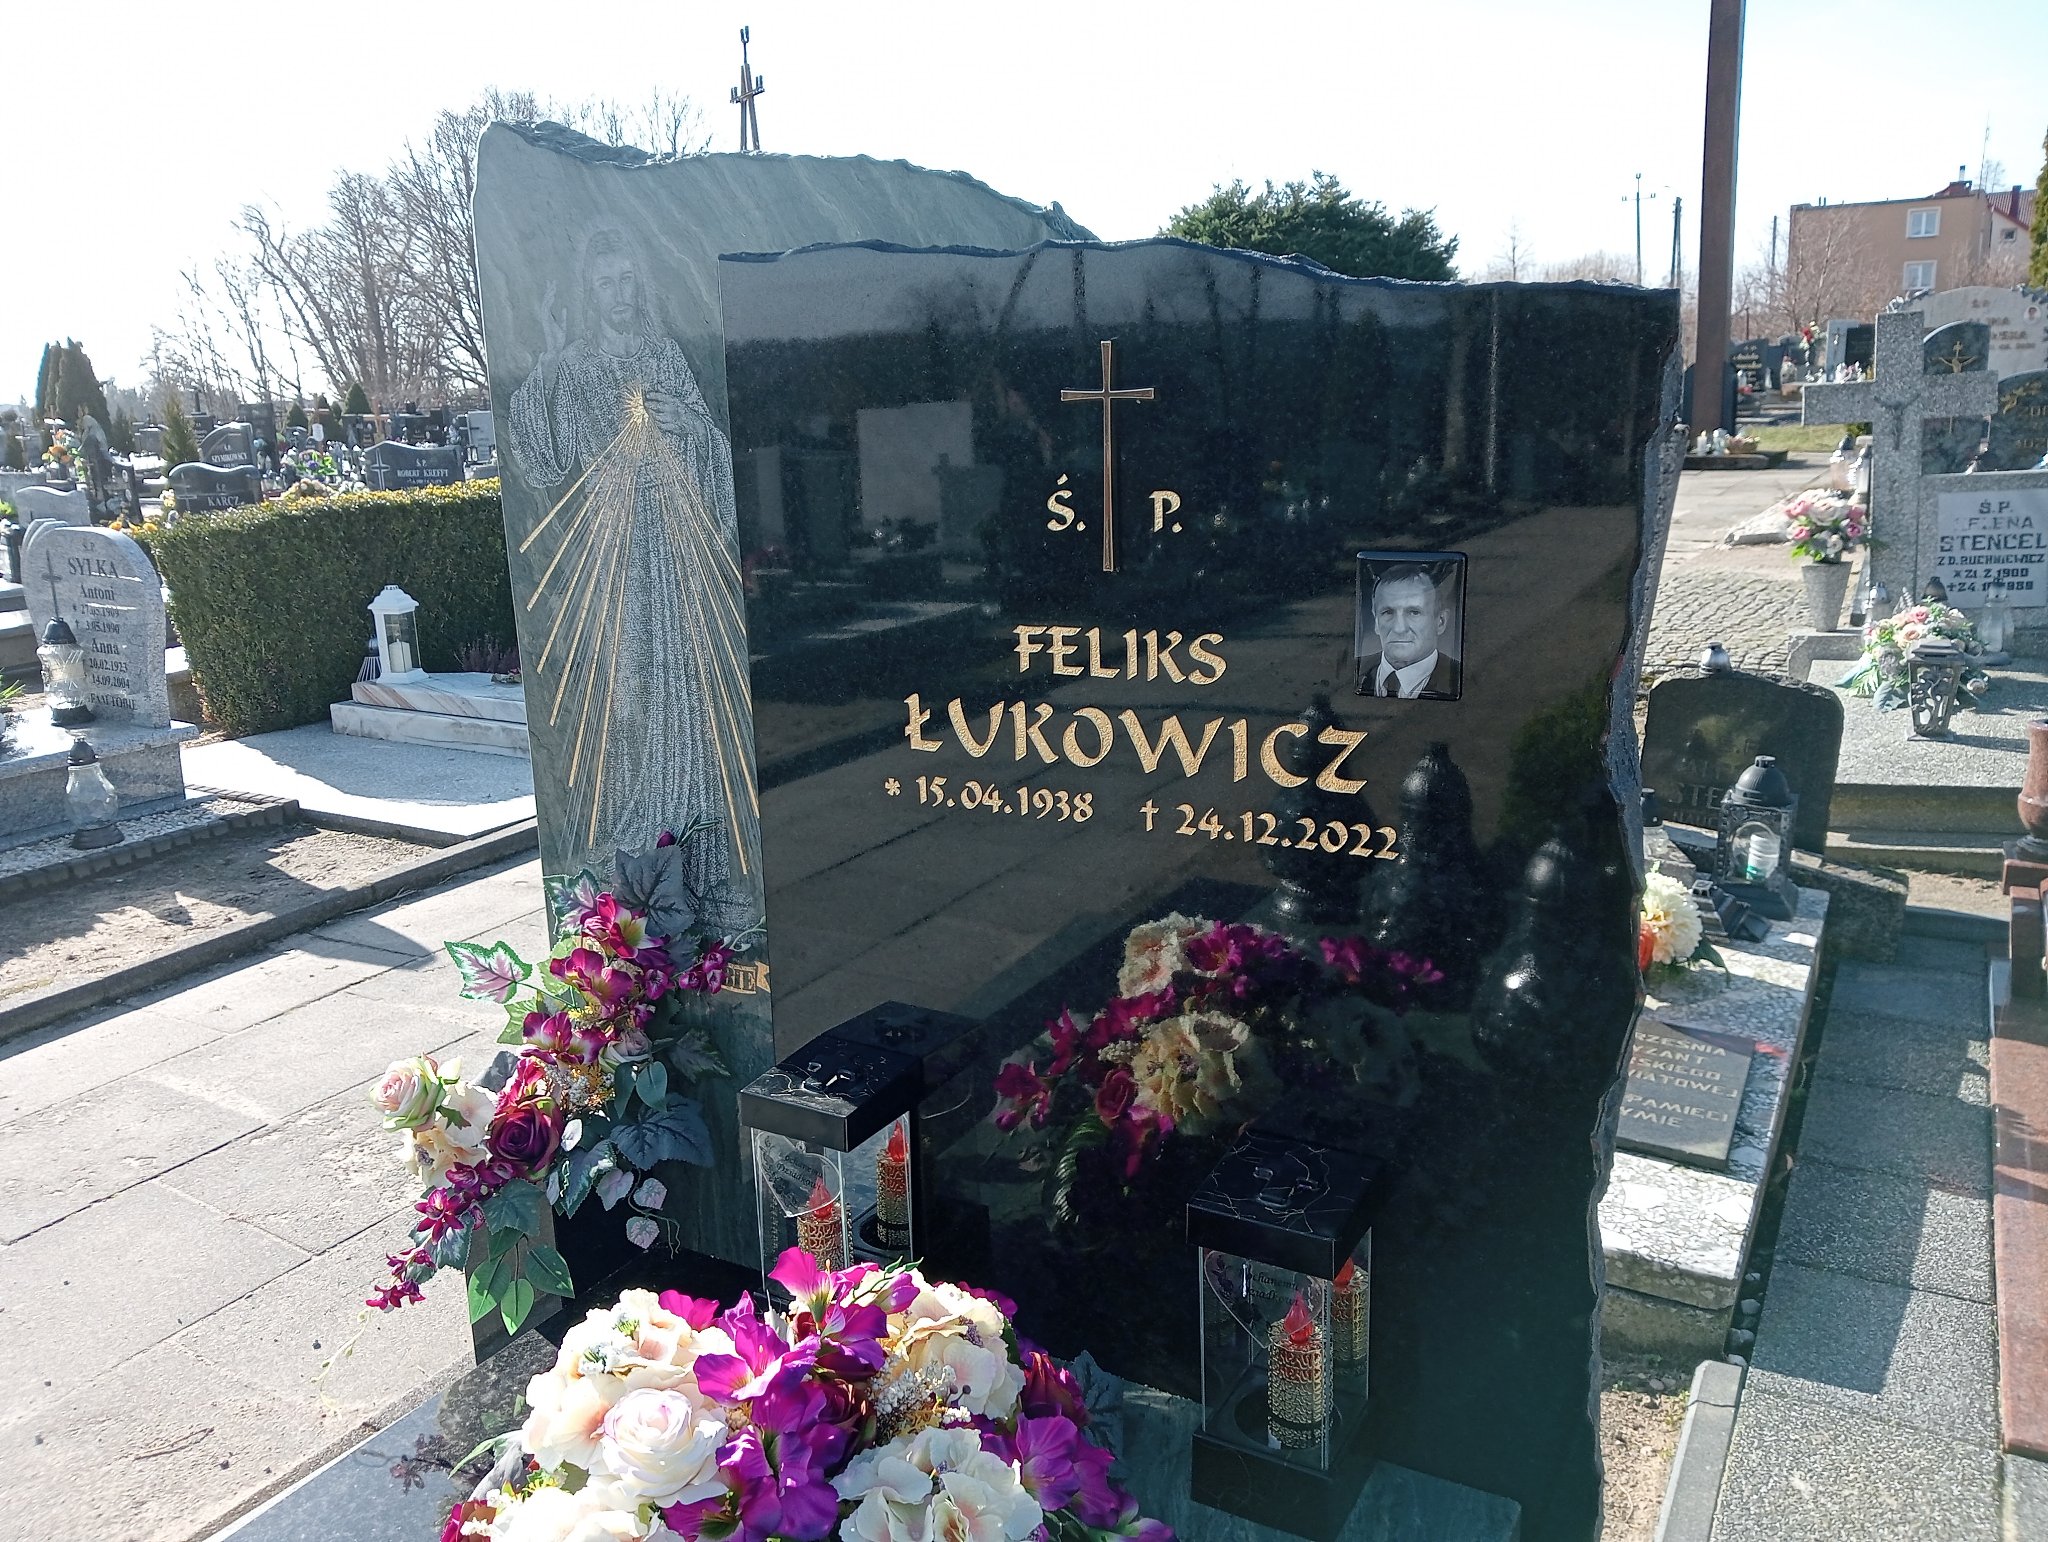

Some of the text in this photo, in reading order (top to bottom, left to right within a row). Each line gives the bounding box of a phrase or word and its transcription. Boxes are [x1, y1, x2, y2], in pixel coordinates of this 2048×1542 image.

[207, 495, 241, 507] KARCZ
[1148, 489, 1183, 534] P.
[1939, 531, 2048, 553] STENCEL
[67, 557, 120, 579] SYLKA
[80, 584, 116, 601] Antoni
[91, 637, 120, 656] Anna
[1012, 623, 1227, 686] FELIKS
[902, 692, 1370, 797] ŁUKOWICZ
[915, 774, 1095, 824] 15.04.1938
[1175, 802, 1401, 862] 24.12.2022
